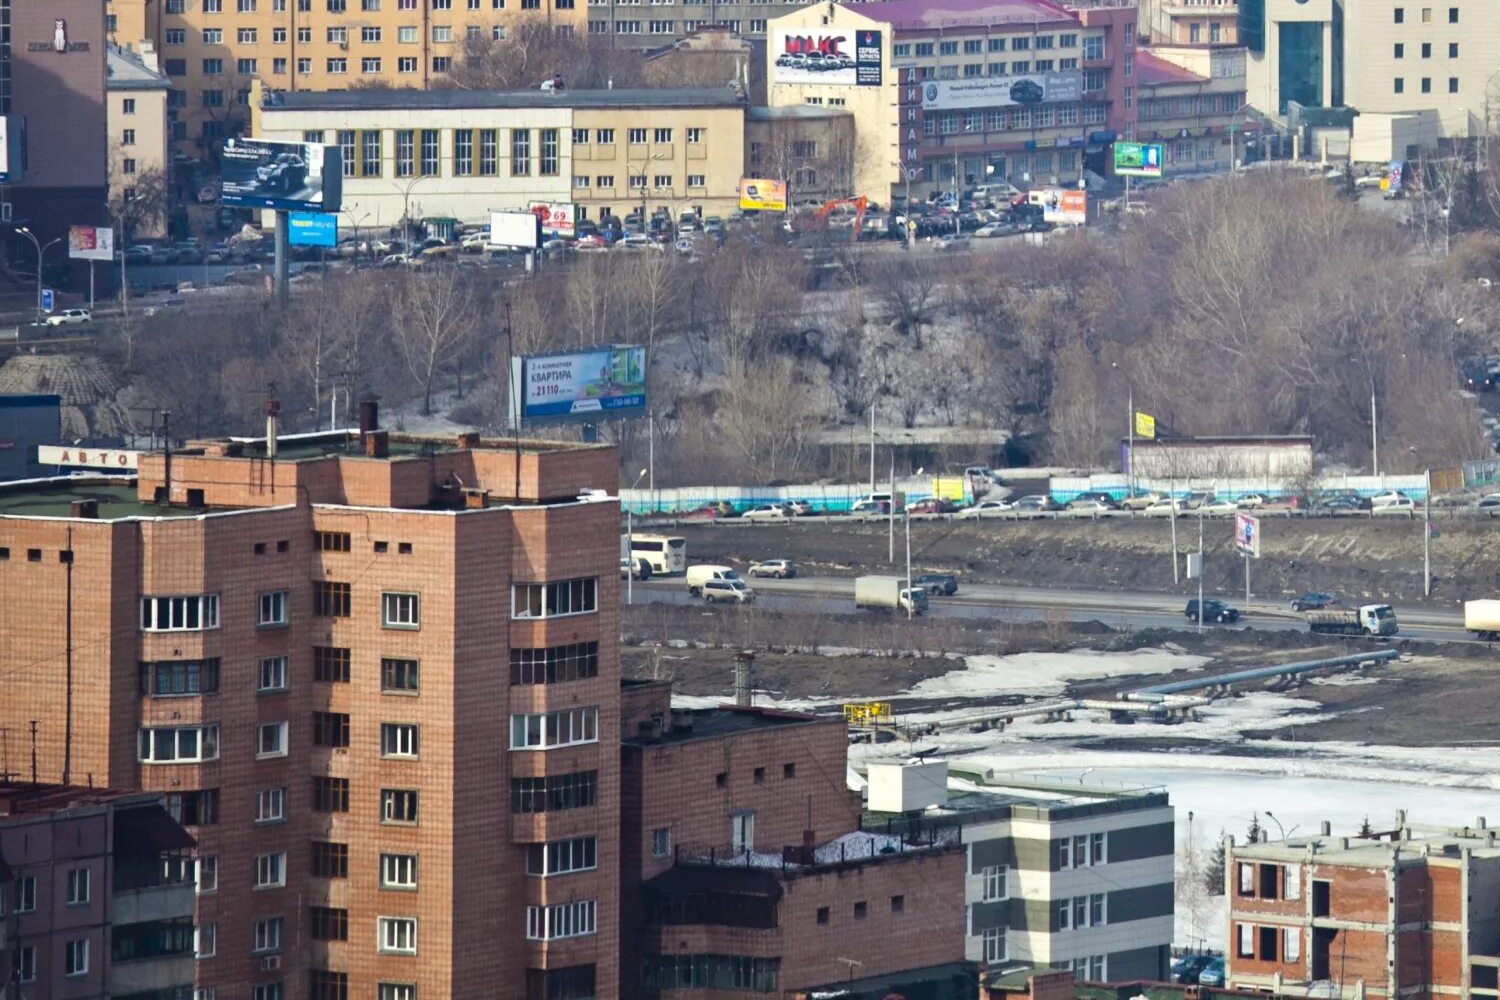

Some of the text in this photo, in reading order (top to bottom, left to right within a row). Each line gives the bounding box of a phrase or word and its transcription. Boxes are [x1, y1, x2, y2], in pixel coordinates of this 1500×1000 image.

[907, 68, 917, 181] ДИНАМО
[531, 370, 572, 383] КВАРТИРА
[62, 451, 128, 465] АВТО
